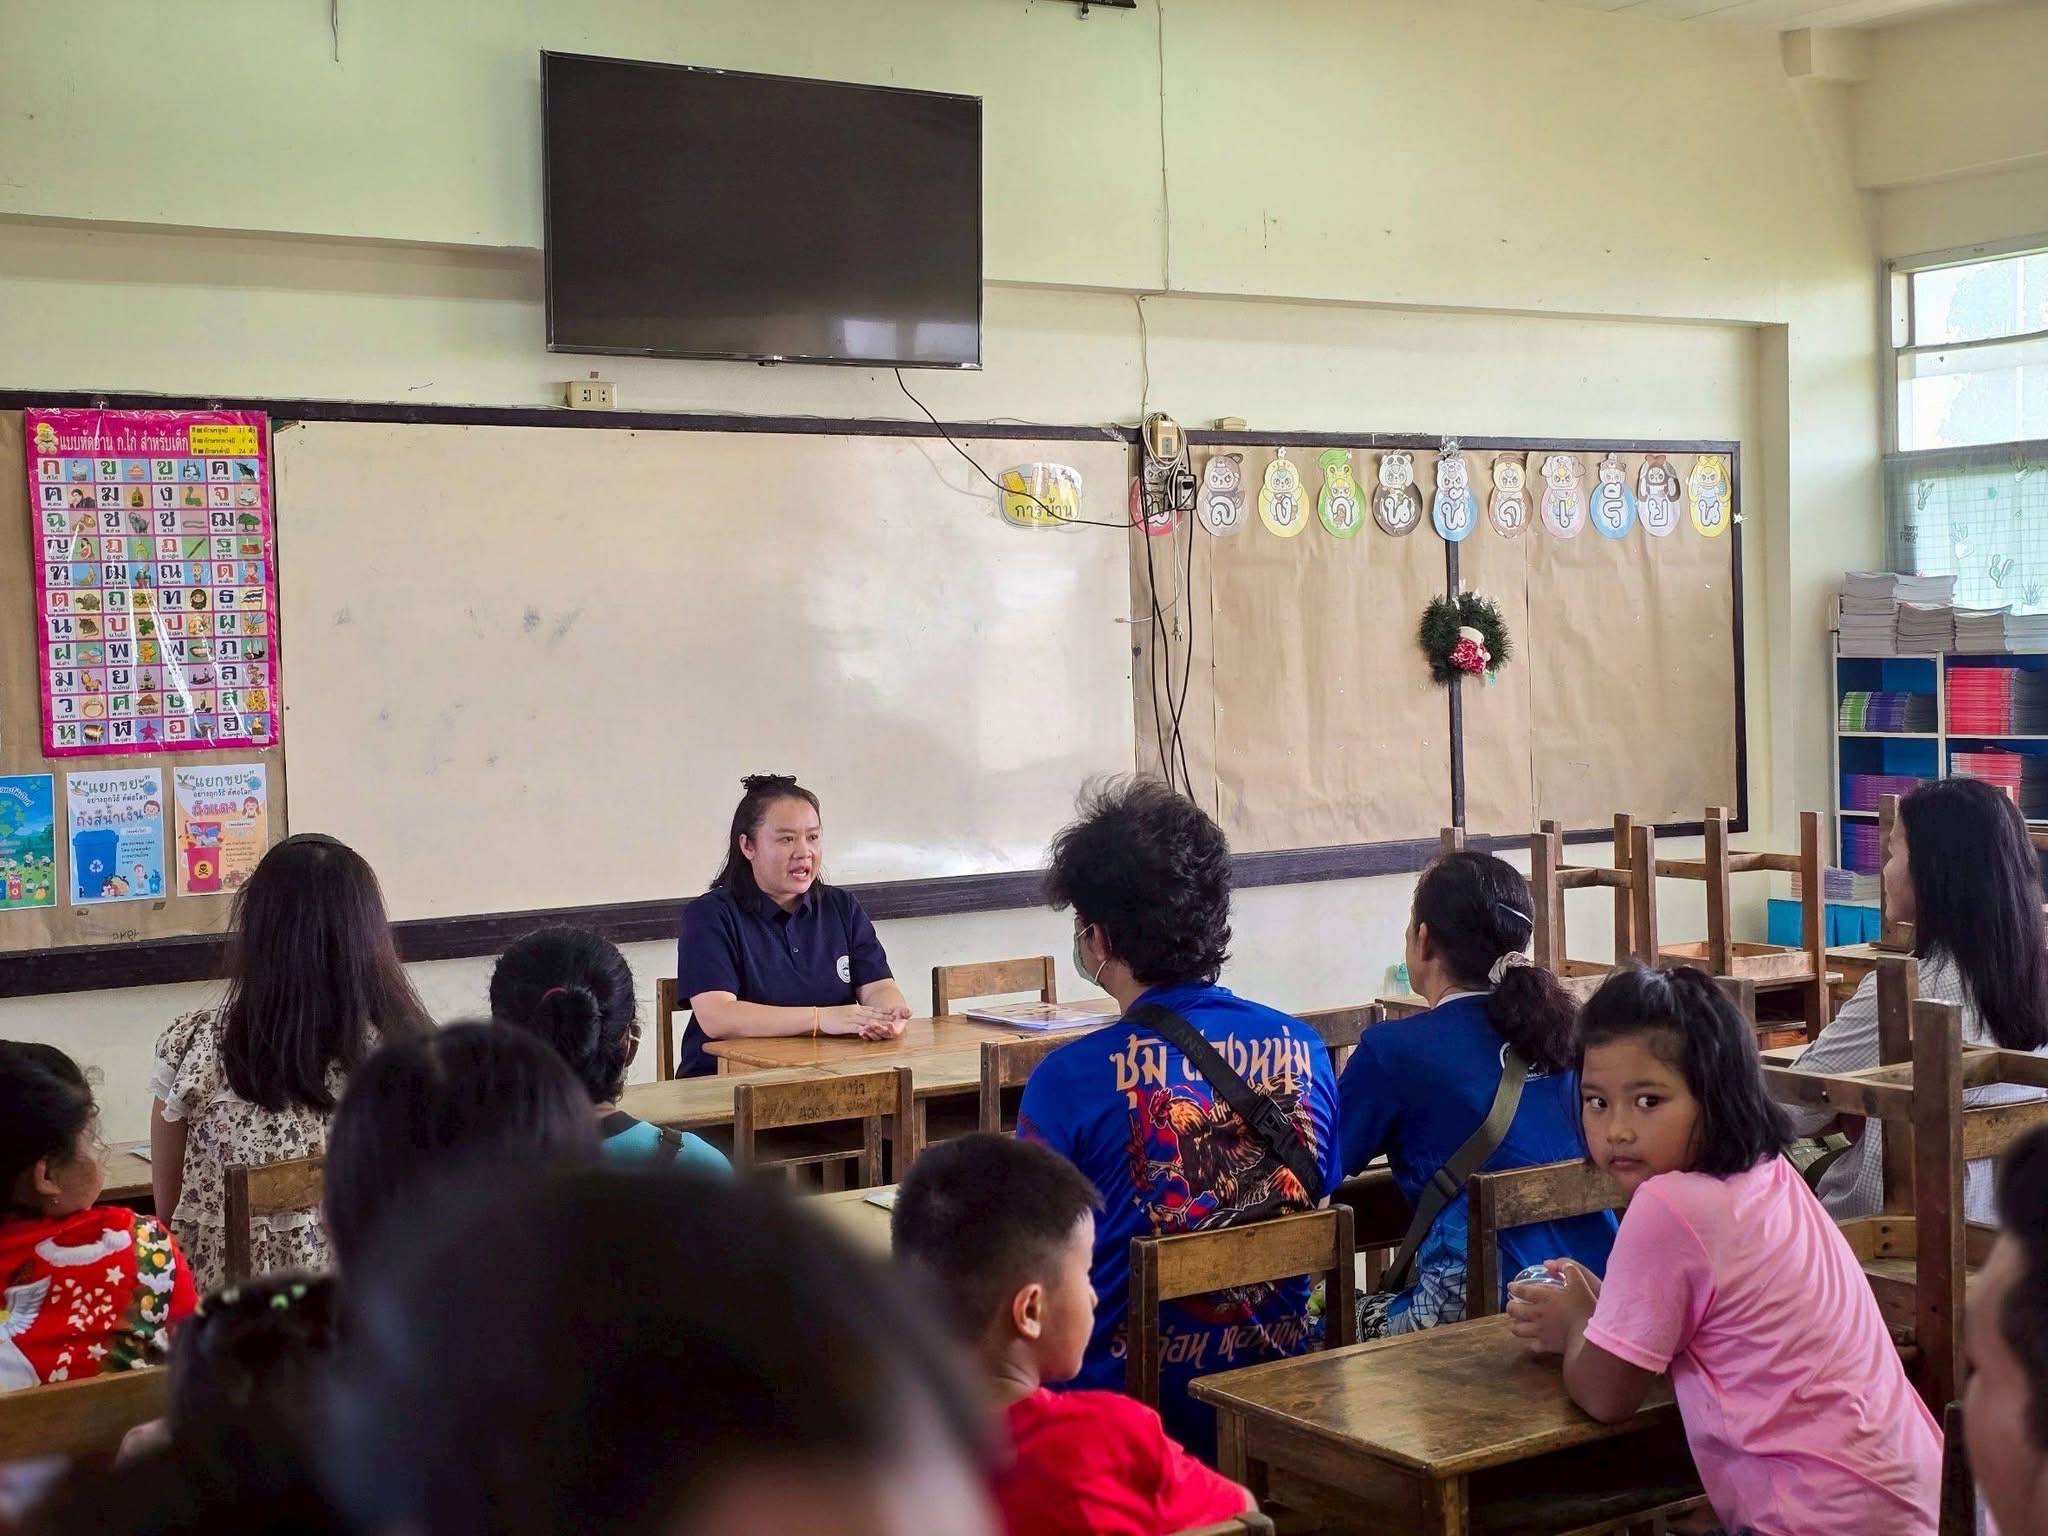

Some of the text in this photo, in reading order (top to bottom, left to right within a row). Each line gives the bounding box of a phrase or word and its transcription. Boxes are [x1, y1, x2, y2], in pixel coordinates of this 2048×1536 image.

[43, 460, 60, 475] ก
[212, 461, 228, 475] ค
[160, 487, 173, 501] ง
[214, 487, 229, 501] จ
[1015, 497, 1073, 518] การบ้าน
[47, 512, 66, 527] ฉ
[161, 565, 182, 578] ณ
[217, 563, 234, 578] ด
[52, 592, 68, 607] ต
[108, 591, 125, 606] ถ
[164, 590, 181, 604] ท
[219, 590, 234, 603] ธ
[52, 618, 72, 633] น
[108, 617, 126, 632] บ
[165, 615, 183, 630] ป
[220, 615, 235, 628] ผ
[55, 644, 71, 660] ฝ
[109, 643, 129, 658] พ
[220, 640, 237, 655] ภ
[55, 671, 73, 686] ม
[112, 670, 128, 685] ย
[222, 666, 236, 680] ล
[58, 698, 73, 712] ว
[113, 694, 130, 710] ศ
[57, 725, 76, 739] ห
[169, 720, 185, 734] อ
[76, 804, 144, 827] ถังสีน้ำเงิน
